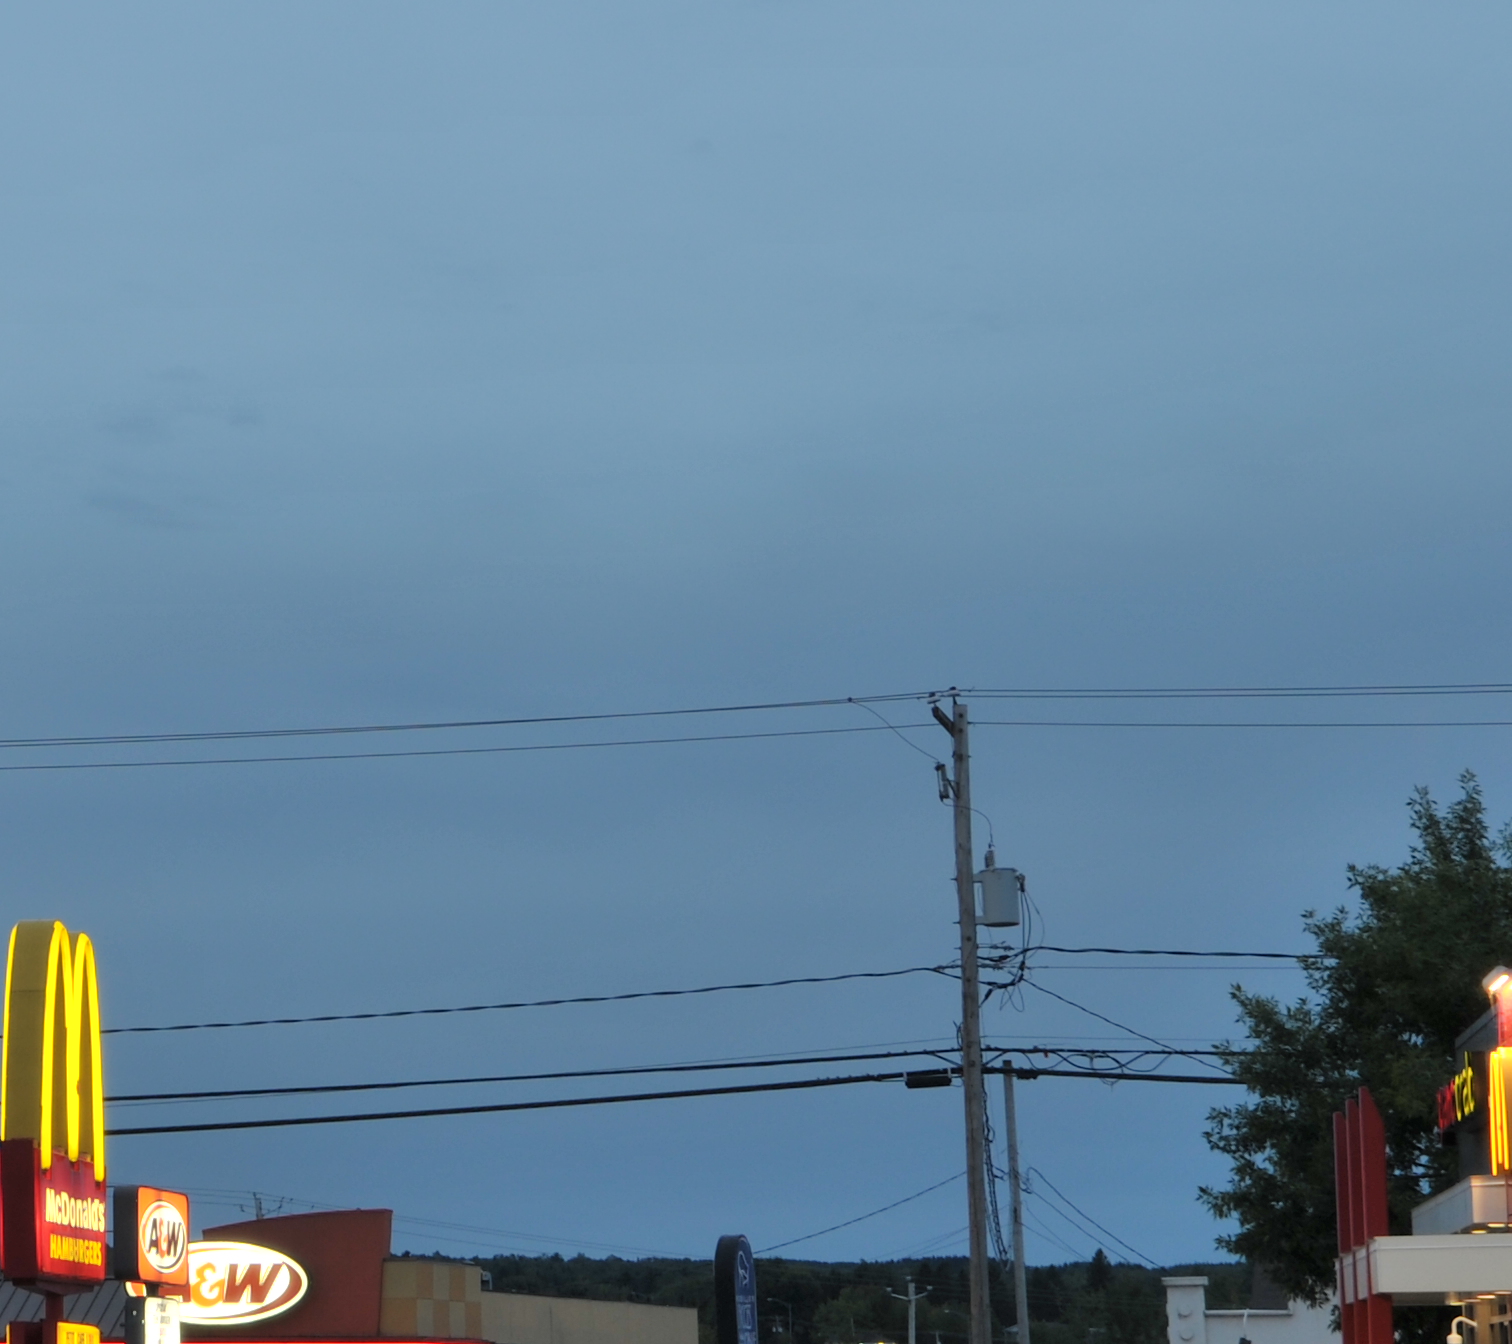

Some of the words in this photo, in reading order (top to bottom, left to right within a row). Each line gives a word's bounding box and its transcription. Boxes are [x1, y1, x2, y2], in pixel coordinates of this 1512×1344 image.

[45, 1187, 105, 1233] McDonald's
[50, 1233, 102, 1267] HAMBURGERS
[147, 1217, 182, 1259] A&W
